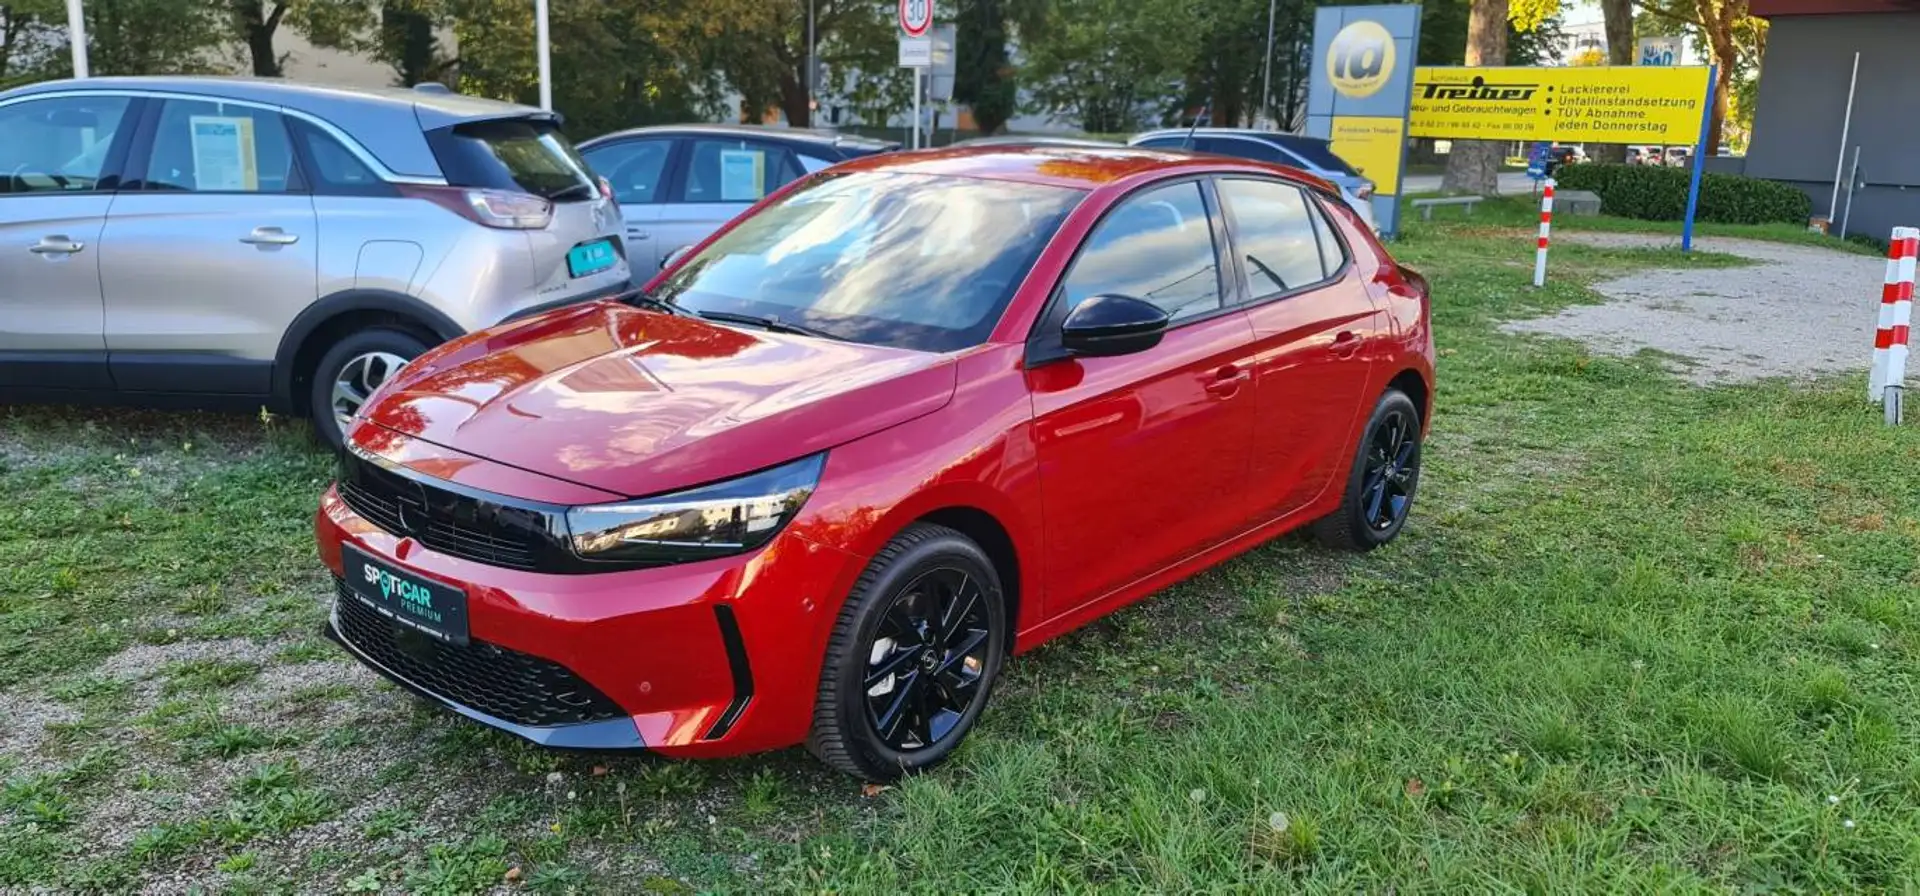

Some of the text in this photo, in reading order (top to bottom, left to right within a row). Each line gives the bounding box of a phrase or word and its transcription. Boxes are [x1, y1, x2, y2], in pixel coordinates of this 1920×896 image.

[907, 0, 926, 21] 30
[1560, 84, 1630, 94] Lackiererei
[1558, 96, 1696, 109] Unfallinstandsetzung
[1432, 103, 1450, 113] und
[1451, 103, 1536, 117] Gebrauchtwagen
[1586, 108, 1646, 119] Abnahme
[1554, 119, 1668, 134] jeden Donnerstag
[401, 598, 442, 623] PREMIUM
